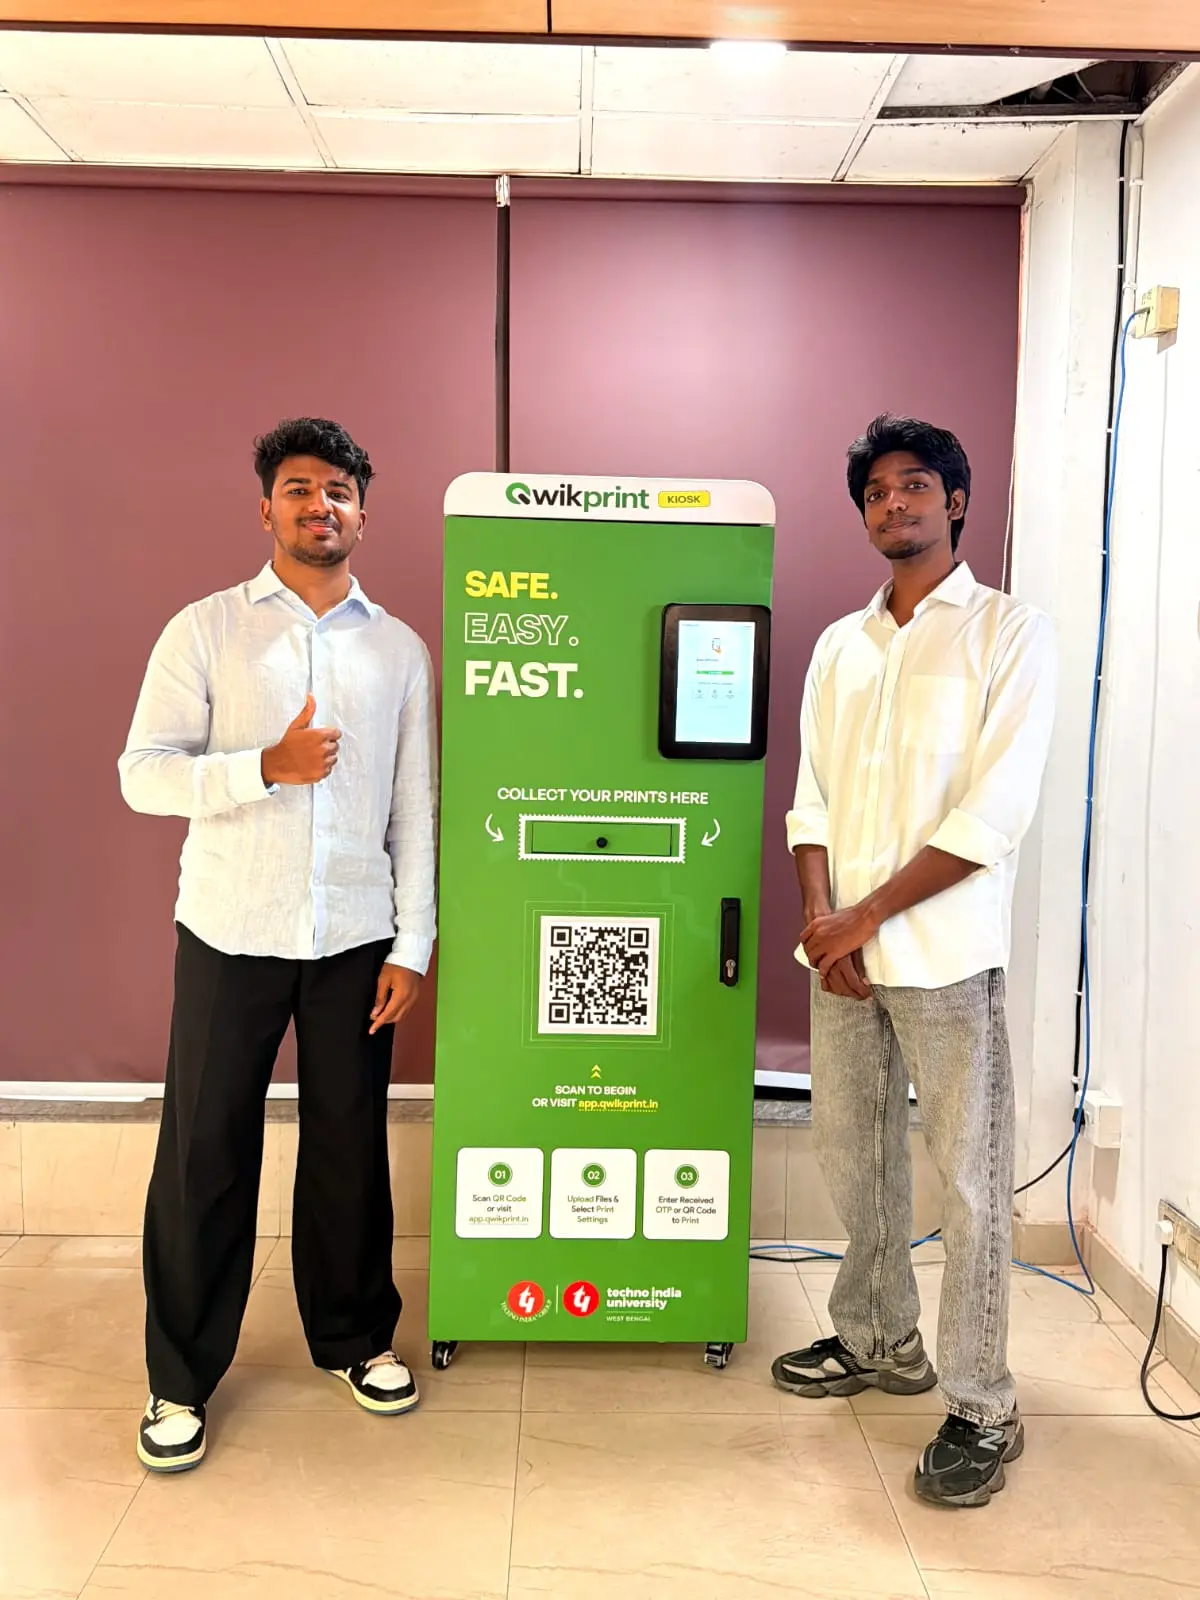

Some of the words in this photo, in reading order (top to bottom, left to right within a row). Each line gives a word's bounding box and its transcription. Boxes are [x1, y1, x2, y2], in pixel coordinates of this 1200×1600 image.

[505, 482, 649, 512] Qwikprint
[667, 495, 701, 504] KIOSK
[465, 570, 558, 600] SAFE.
[464, 612, 579, 647] EASY.
[465, 659, 584, 699] FAST.
[497, 787, 568, 802] COLLECT
[569, 788, 611, 803] YOUR
[613, 790, 667, 804] PRINTS
[670, 791, 709, 805] HERE
[555, 1085, 586, 1095] SCAN
[587, 1085, 602, 1095] TO
[604, 1086, 637, 1095] BEGIN
[532, 1097, 548, 1107] OR
[549, 1098, 577, 1107] VISIT
[578, 1099, 658, 1111] app.qwikprint.in
[494, 1170, 506, 1179] 01
[587, 1170, 600, 1180] 02
[680, 1172, 694, 1181] 03
[472, 1194, 491, 1202] Scan
[492, 1194, 505, 1202] QR
[506, 1194, 527, 1202] Code
[567, 1195, 594, 1204] Upload
[595, 1195, 613, 1203] Files
[613, 1195, 619, 1203] &
[658, 1196, 678, 1204] Enter
[680, 1196, 714, 1204] Received
[571, 1205, 594, 1213] Select
[596, 1205, 614, 1213] Print
[655, 1206, 672, 1214] OTP
[682, 1206, 694, 1214] QR
[468, 1216, 529, 1225] app.qwikprint.in
[577, 1216, 608, 1225] Settings
[681, 1217, 699, 1225] Print
[606, 1287, 649, 1298] techno
[651, 1286, 682, 1298] india
[606, 1297, 667, 1310] university
